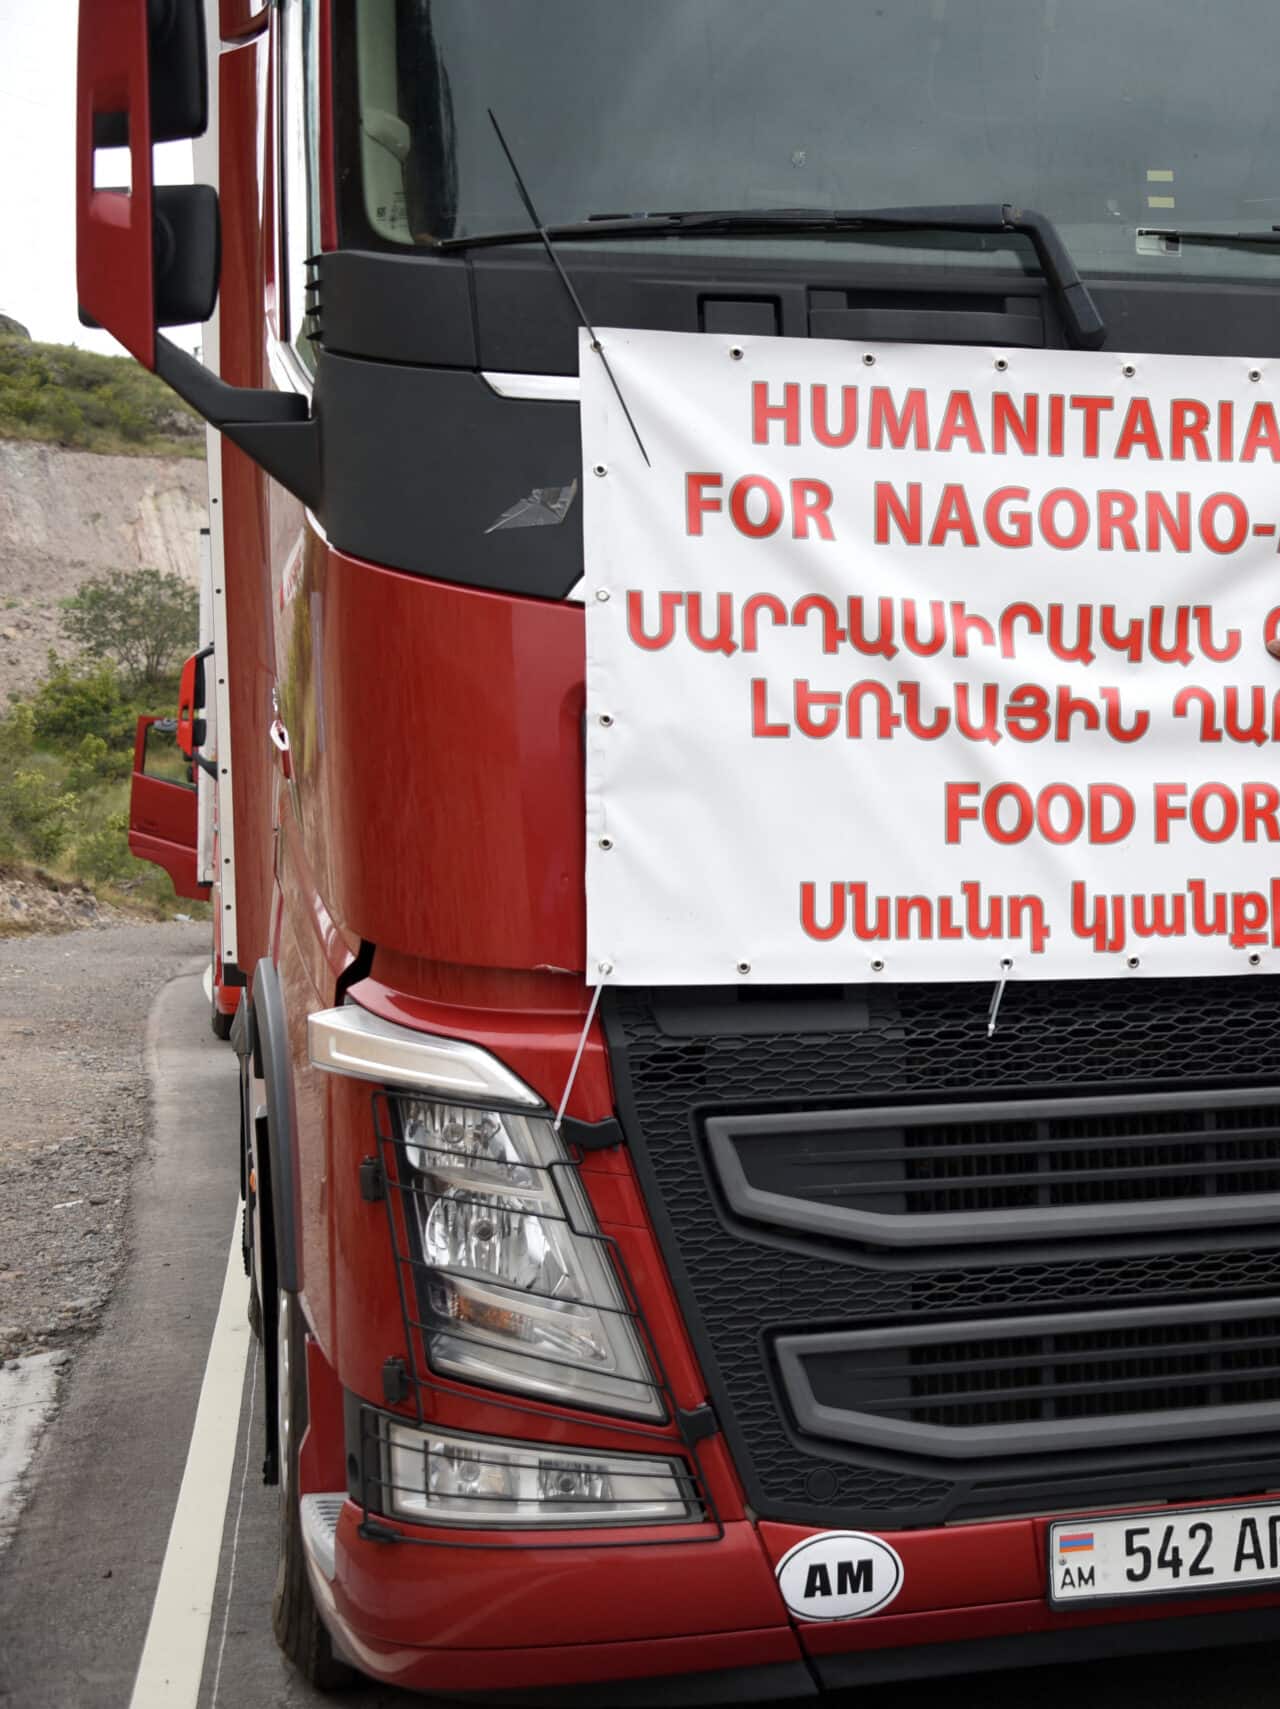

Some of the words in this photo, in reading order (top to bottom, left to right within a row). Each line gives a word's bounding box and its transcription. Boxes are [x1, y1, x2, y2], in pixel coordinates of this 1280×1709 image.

[685, 471, 836, 542] FOR
[626, 589, 1243, 667] ՄԱՐԴԱՍԻՐԱԿԱՆ
[750, 677, 1151, 746] ԼԵՌՆԱՅԻՆ
[944, 781, 1137, 846] FOOD
[799, 880, 1052, 955] Սնունդ
[803, 1558, 874, 1599] AM
[1060, 1565, 1096, 1591] AM
[1124, 1522, 1215, 1583] 542
